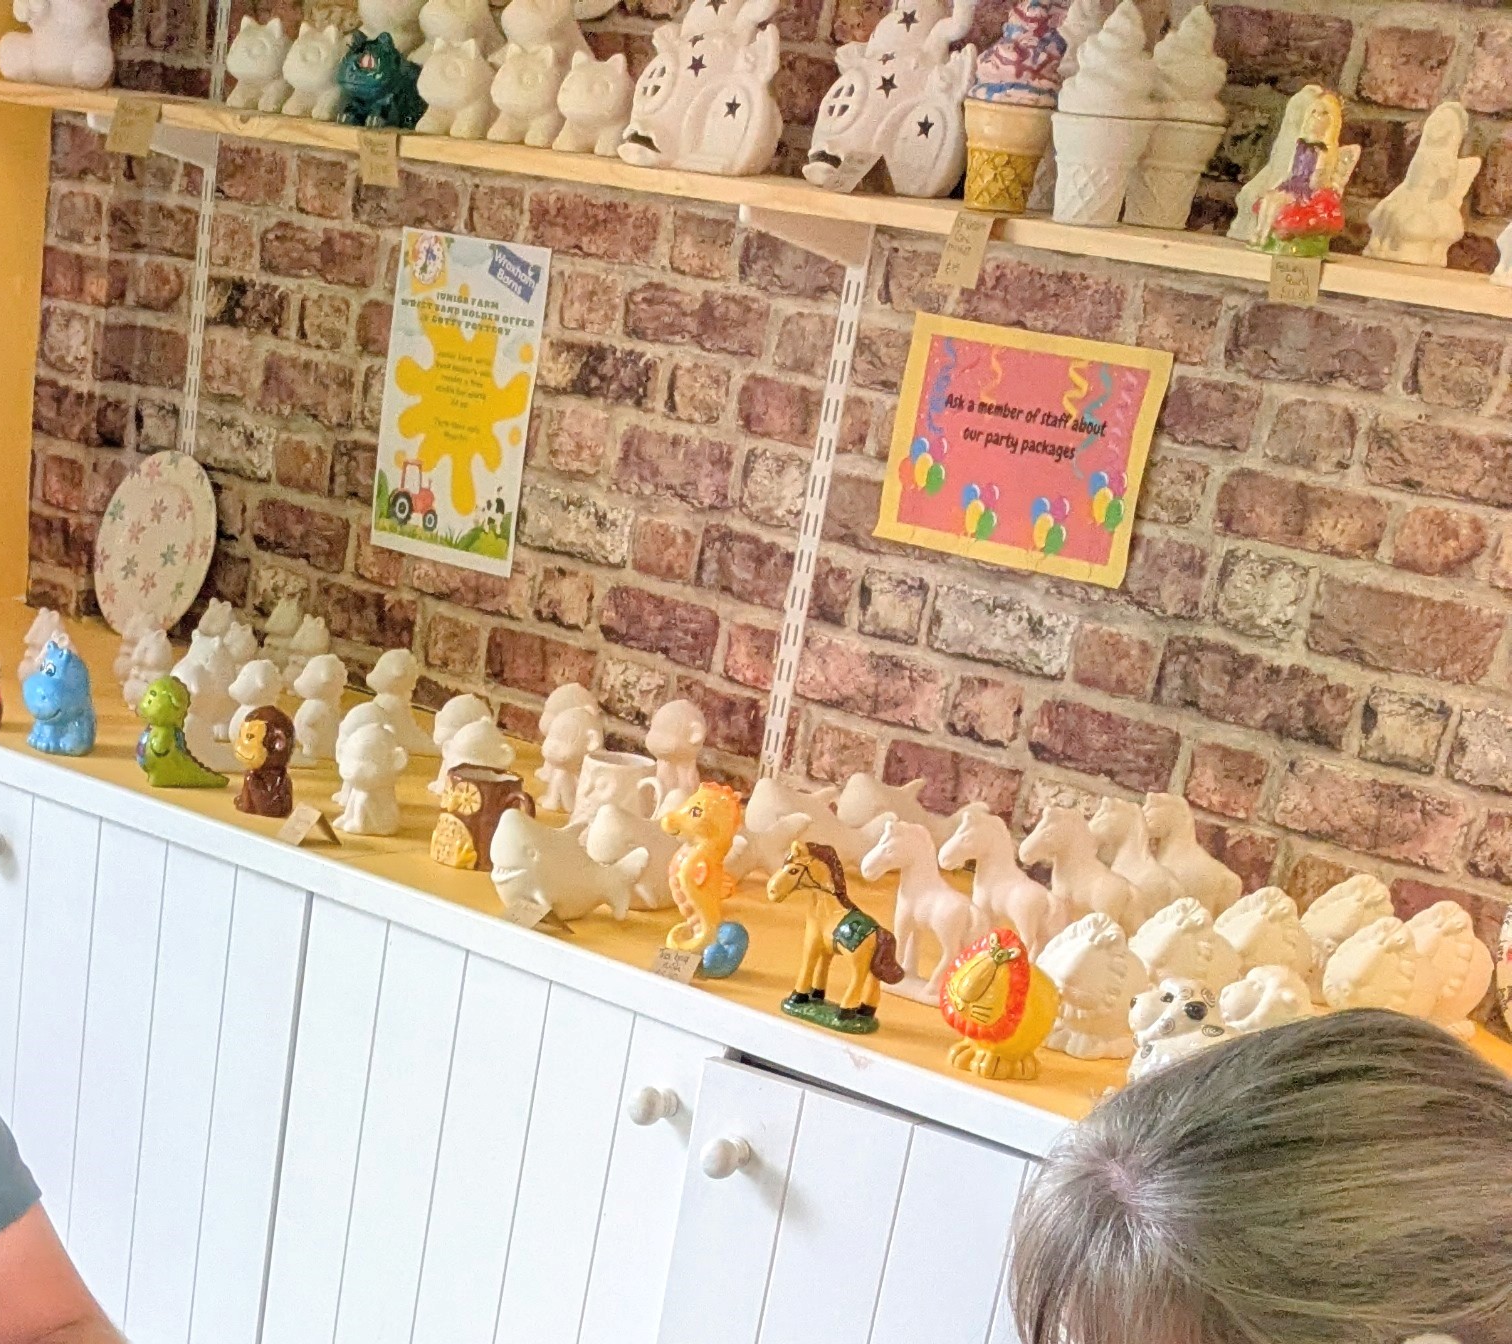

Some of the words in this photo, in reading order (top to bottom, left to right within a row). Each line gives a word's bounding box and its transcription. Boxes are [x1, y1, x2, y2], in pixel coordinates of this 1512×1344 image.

[497, 267, 522, 295] Barns
[471, 298, 499, 310] FARM
[502, 315, 534, 328] OFFER
[945, 393, 965, 409] Ask
[967, 400, 975, 413] a
[977, 401, 1024, 420] member
[1025, 408, 1041, 424] of
[1040, 411, 1072, 428] staff
[1071, 415, 1108, 437] about
[963, 426, 984, 441] our
[984, 431, 1019, 454] party
[1020, 439, 1076, 462] packages
